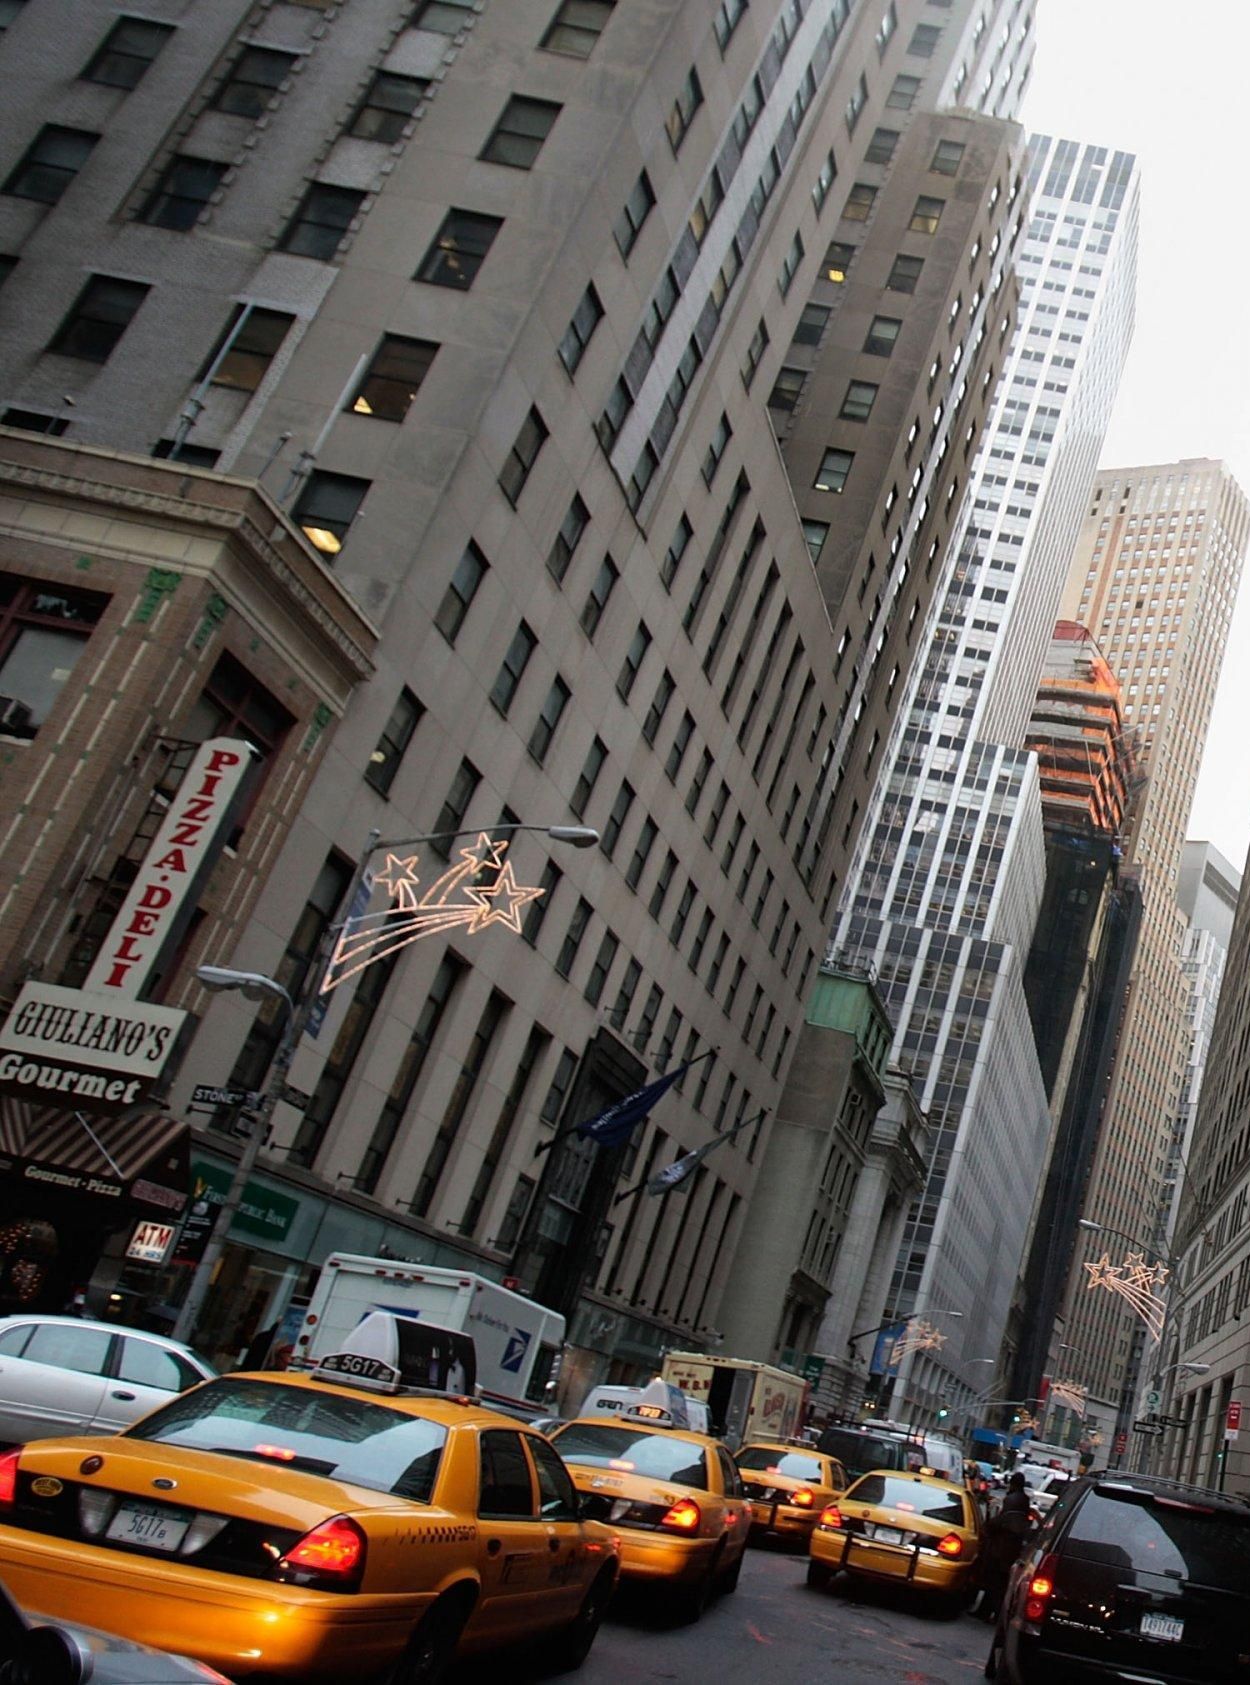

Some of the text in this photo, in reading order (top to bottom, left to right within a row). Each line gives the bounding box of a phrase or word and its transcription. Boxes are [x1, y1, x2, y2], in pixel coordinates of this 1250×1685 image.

[153, 749, 240, 873] PIZZA
[104, 884, 173, 988] DELI
[13, 1000, 172, 1061] GIULIANO'S
[0, 1053, 142, 1104] Gourmet
[195, 1088, 234, 1104] STONE
[24, 1165, 83, 1188] Gourmet
[86, 1178, 123, 1197] Pizza
[133, 1224, 173, 1249] ATM
[340, 1355, 379, 1376] 5G17
